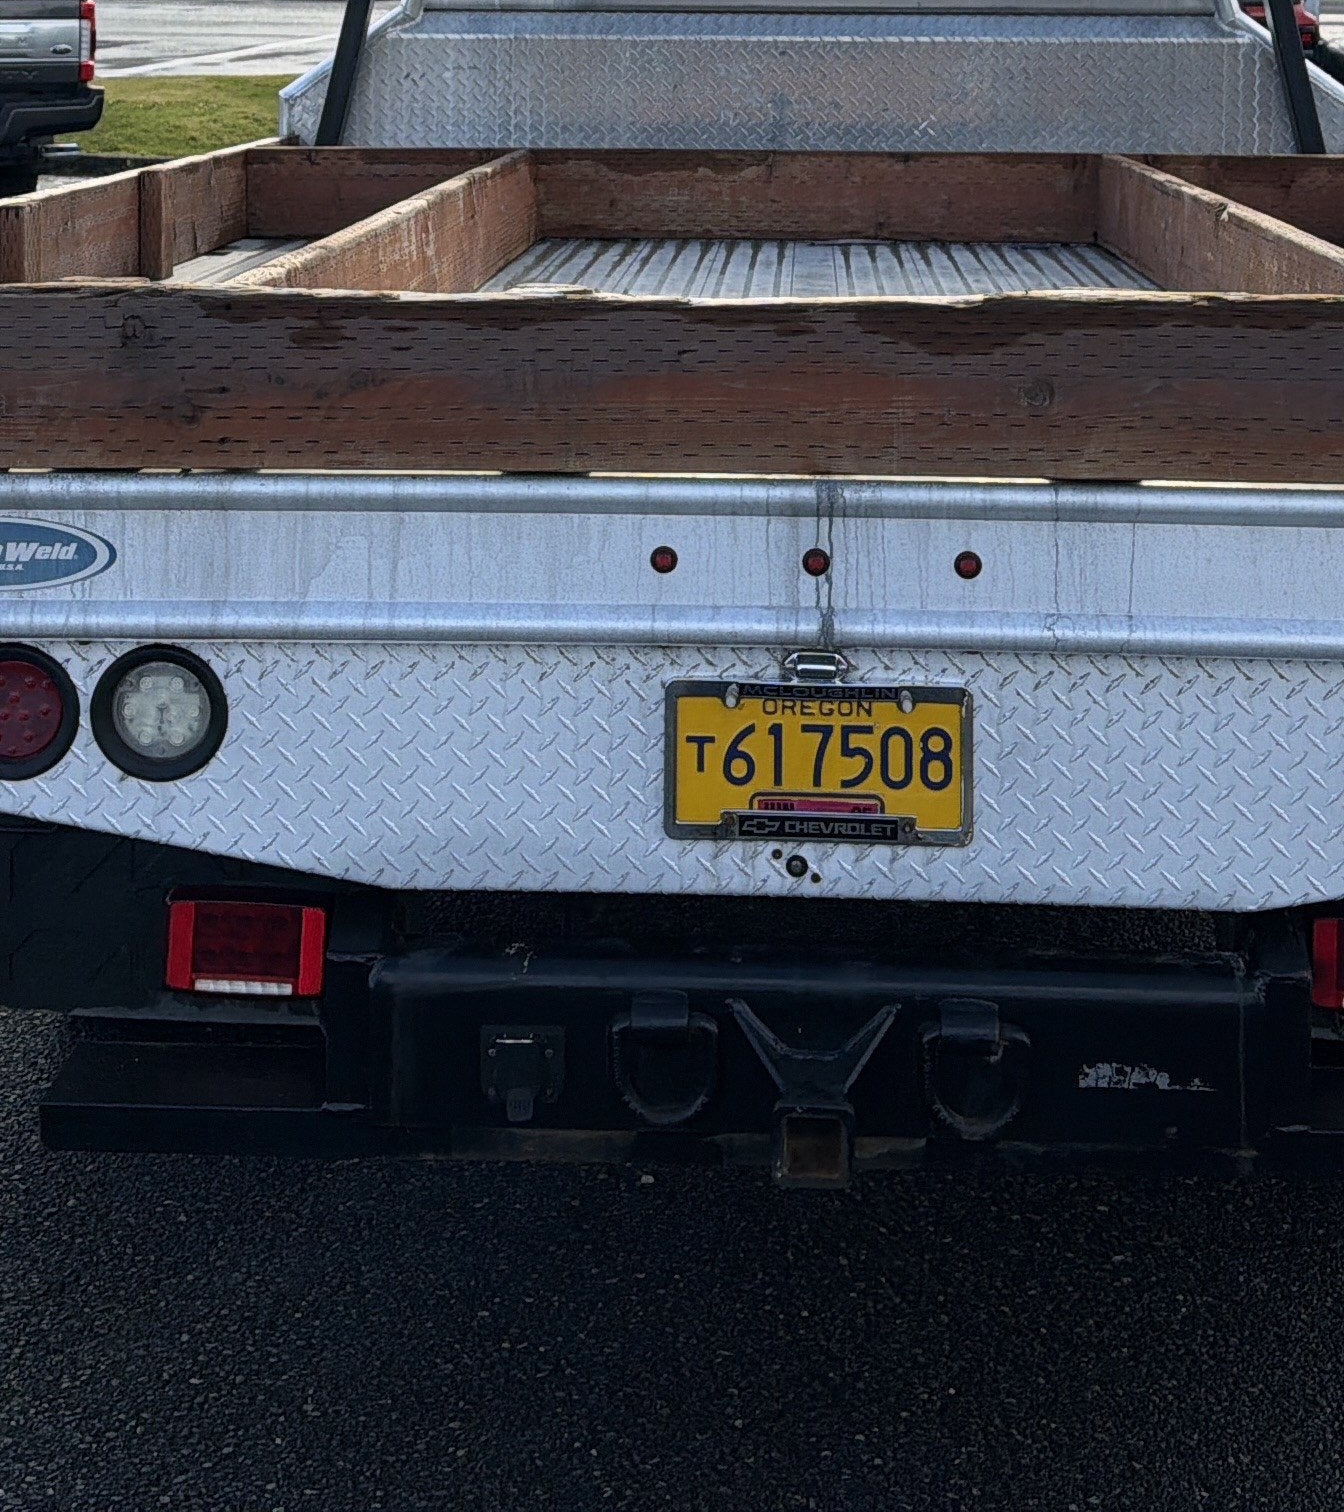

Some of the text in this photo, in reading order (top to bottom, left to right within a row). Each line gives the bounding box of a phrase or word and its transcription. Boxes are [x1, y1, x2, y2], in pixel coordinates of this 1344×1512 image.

[6, 542, 78, 562] Weld
[742, 686, 898, 699] MCLOUGHLIN
[762, 698, 873, 717] OREGON
[784, 821, 897, 837] CHEVROLET
